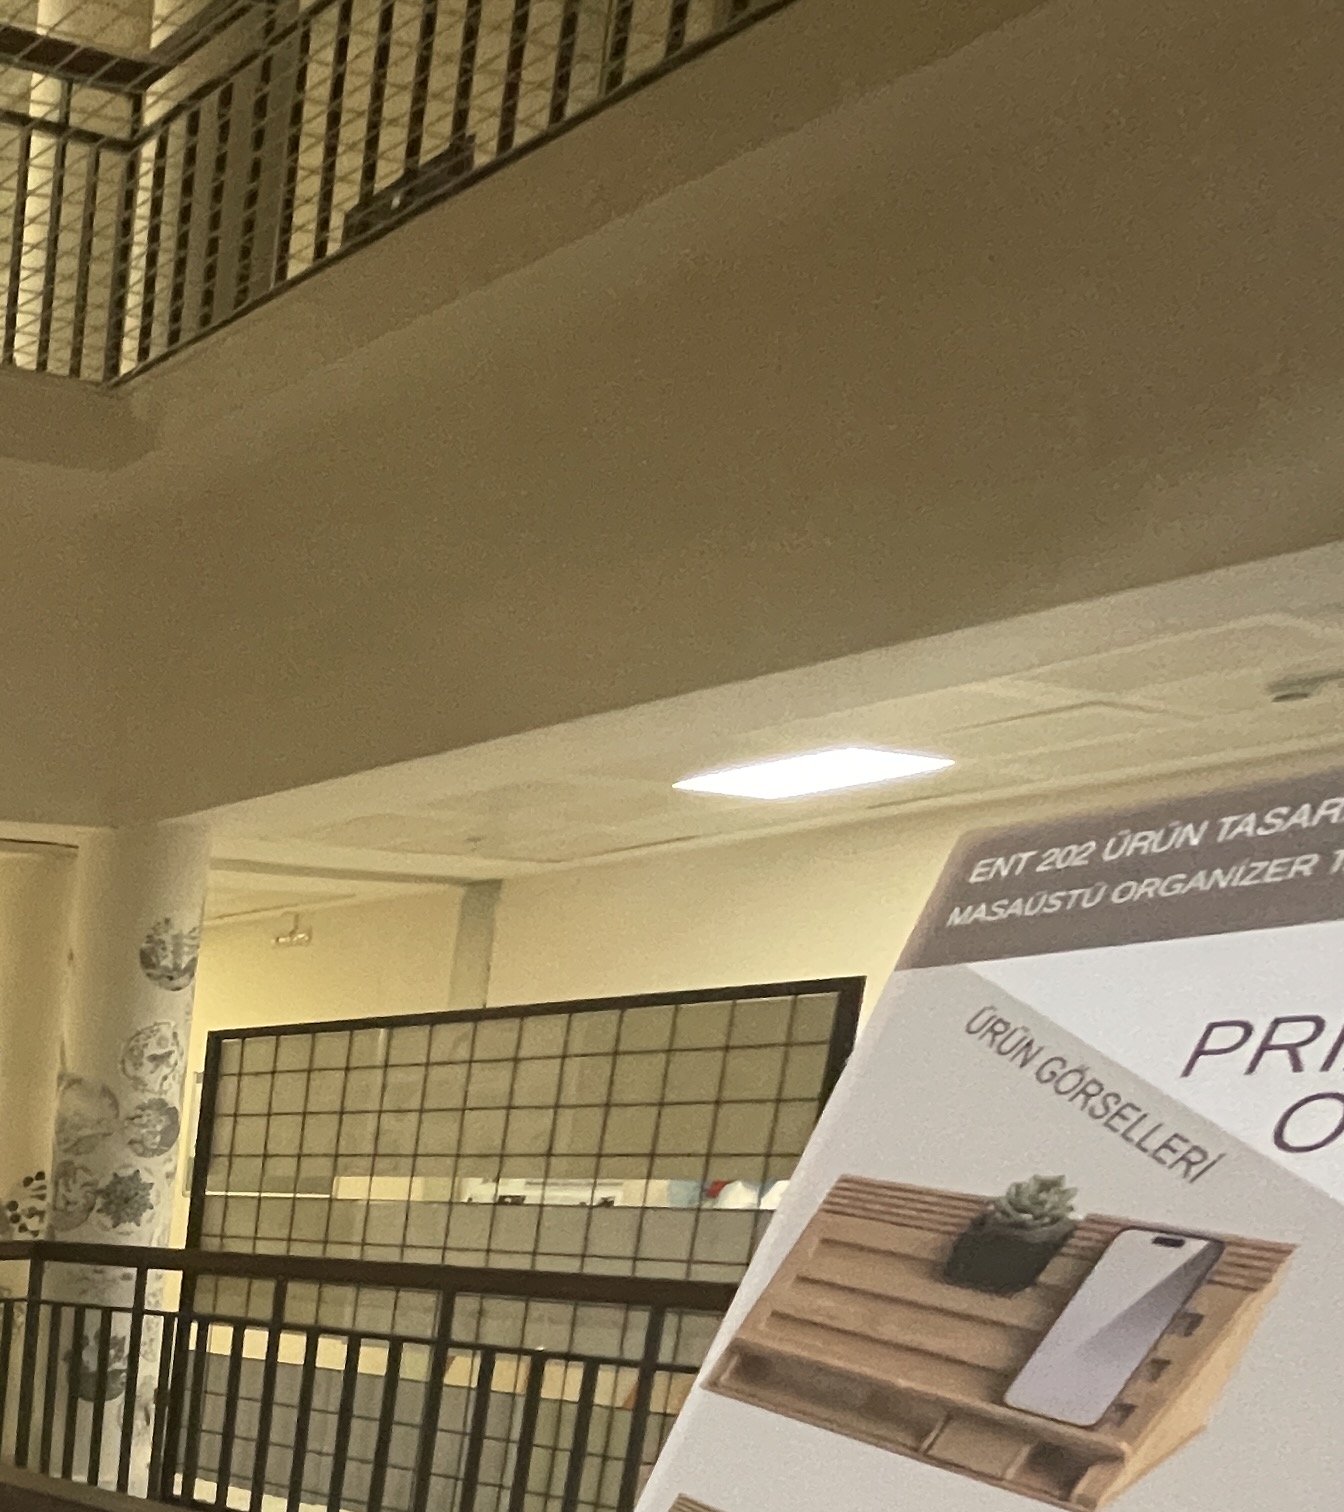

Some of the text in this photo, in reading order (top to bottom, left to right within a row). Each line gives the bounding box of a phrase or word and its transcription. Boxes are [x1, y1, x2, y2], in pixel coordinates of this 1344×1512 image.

[968, 796, 1344, 884] ENT 202 ÜRÜN TASAR
[945, 882, 1108, 928] MASAÜSTÜ
[964, 1004, 1045, 1070] ÜRÜN
[1179, 1014, 1344, 1079] PRI
